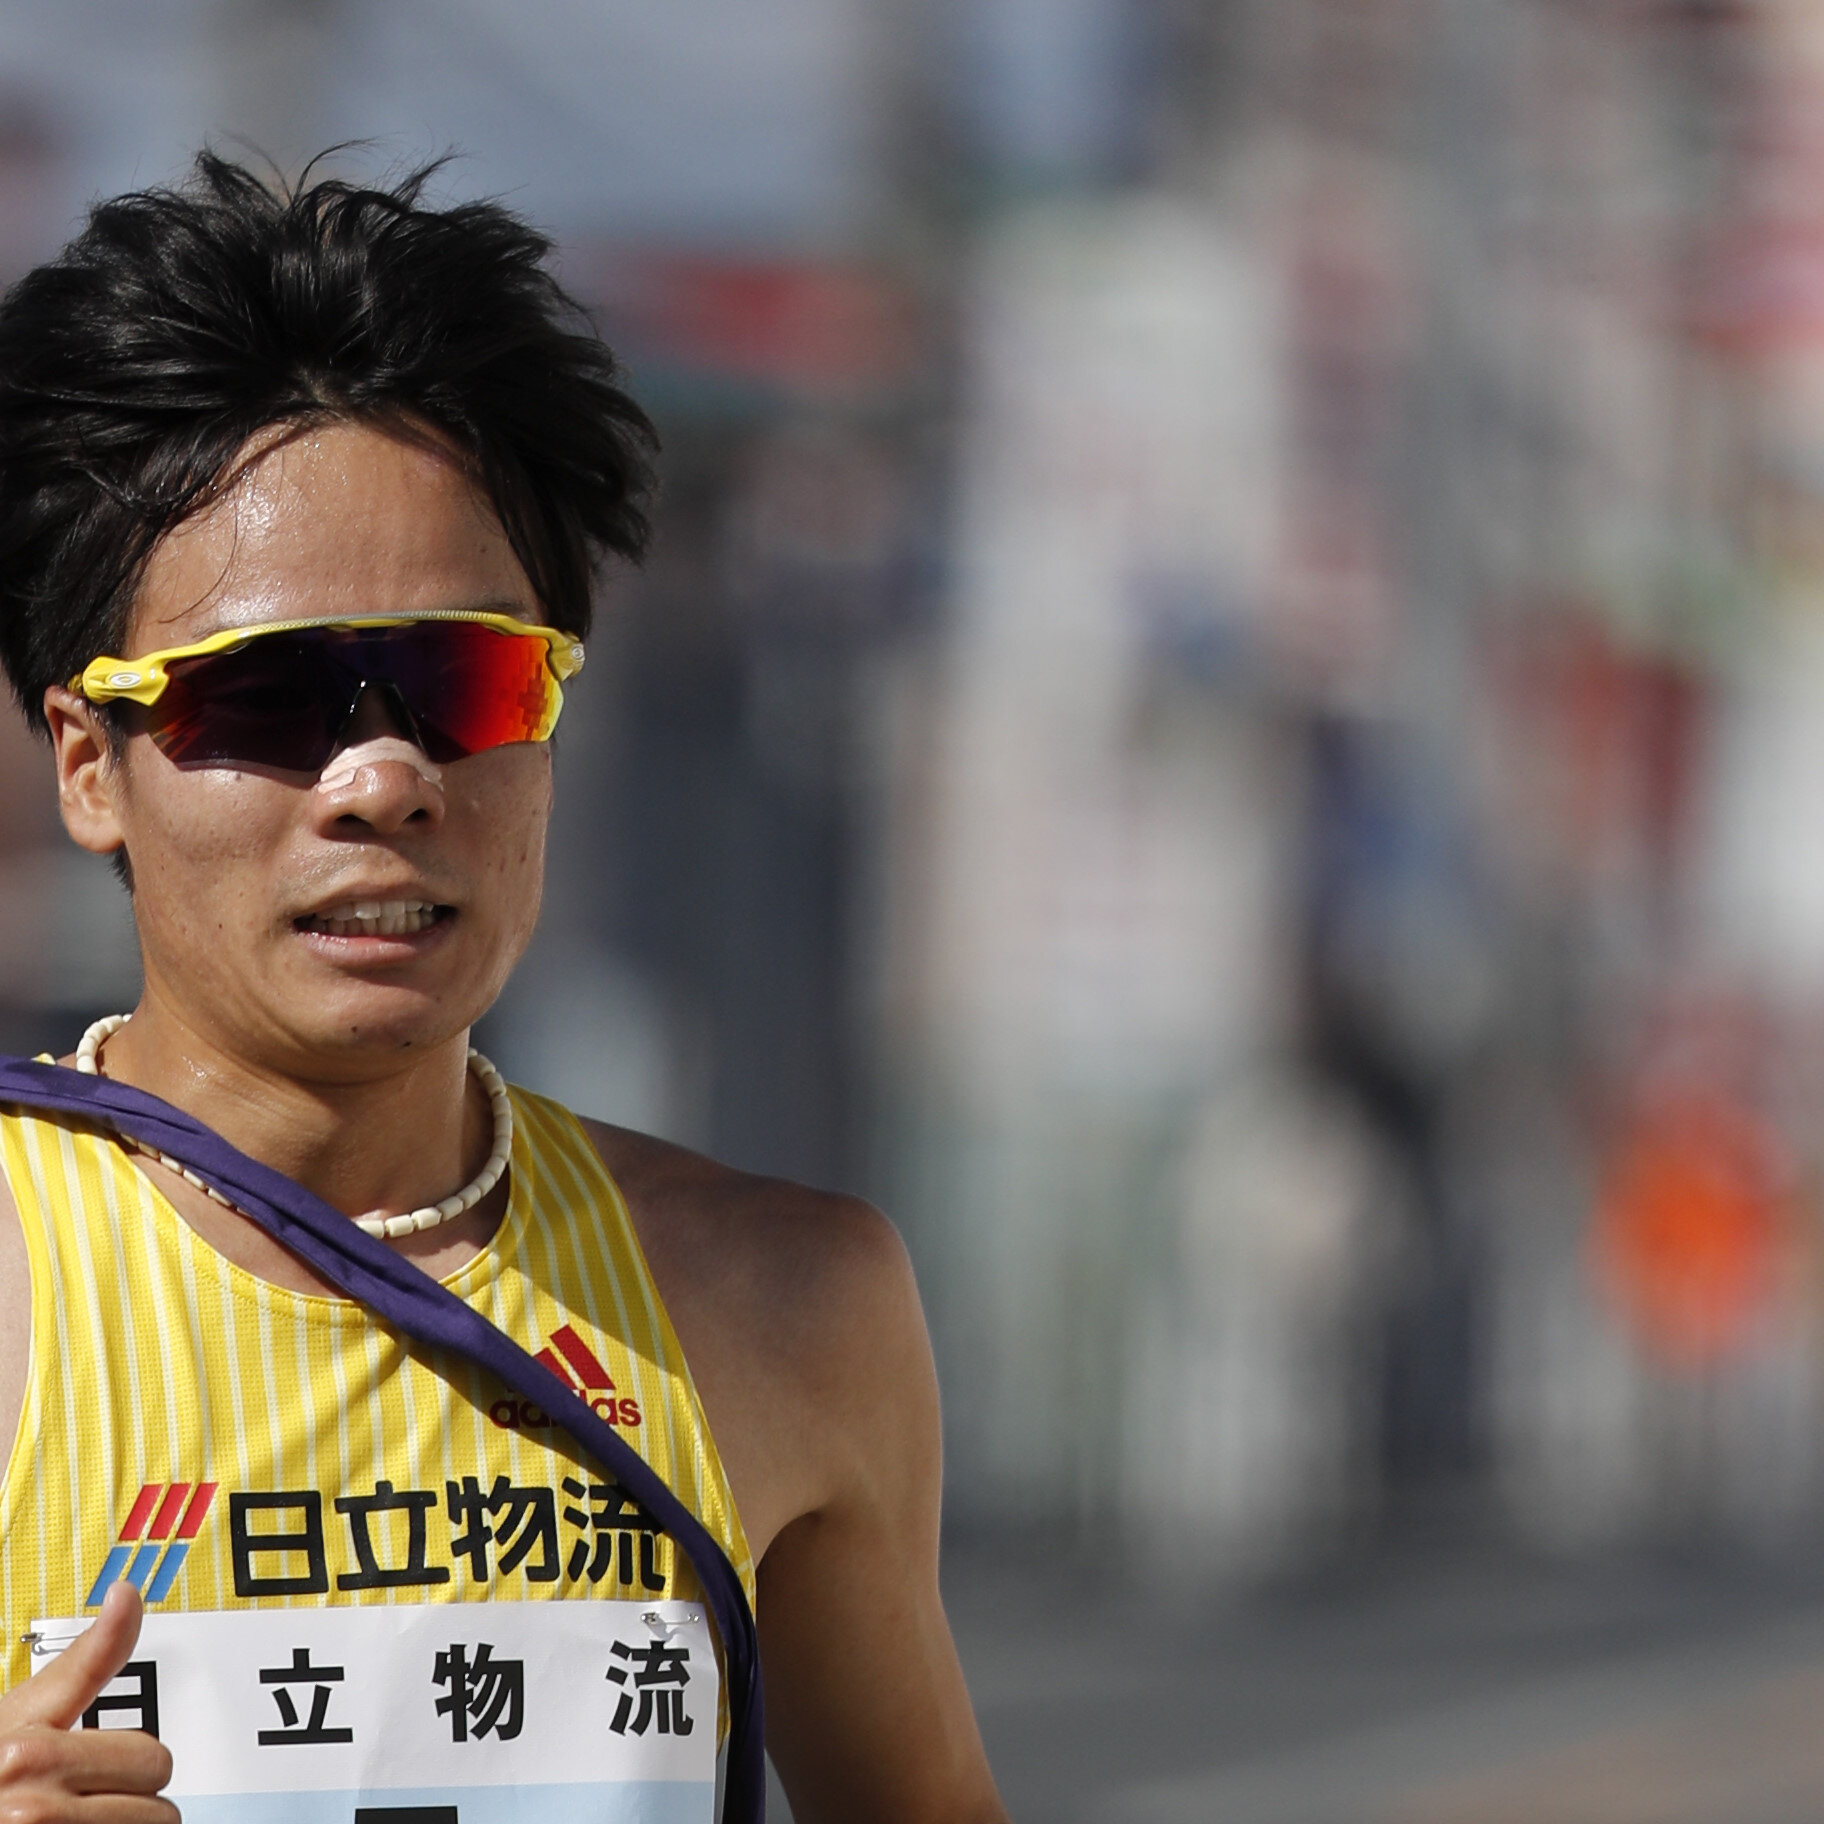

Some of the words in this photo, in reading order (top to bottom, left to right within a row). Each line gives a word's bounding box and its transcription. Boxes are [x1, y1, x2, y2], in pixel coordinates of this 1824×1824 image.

[487, 1388, 641, 1430] adas
[230, 1475, 665, 1598] 日立物流
